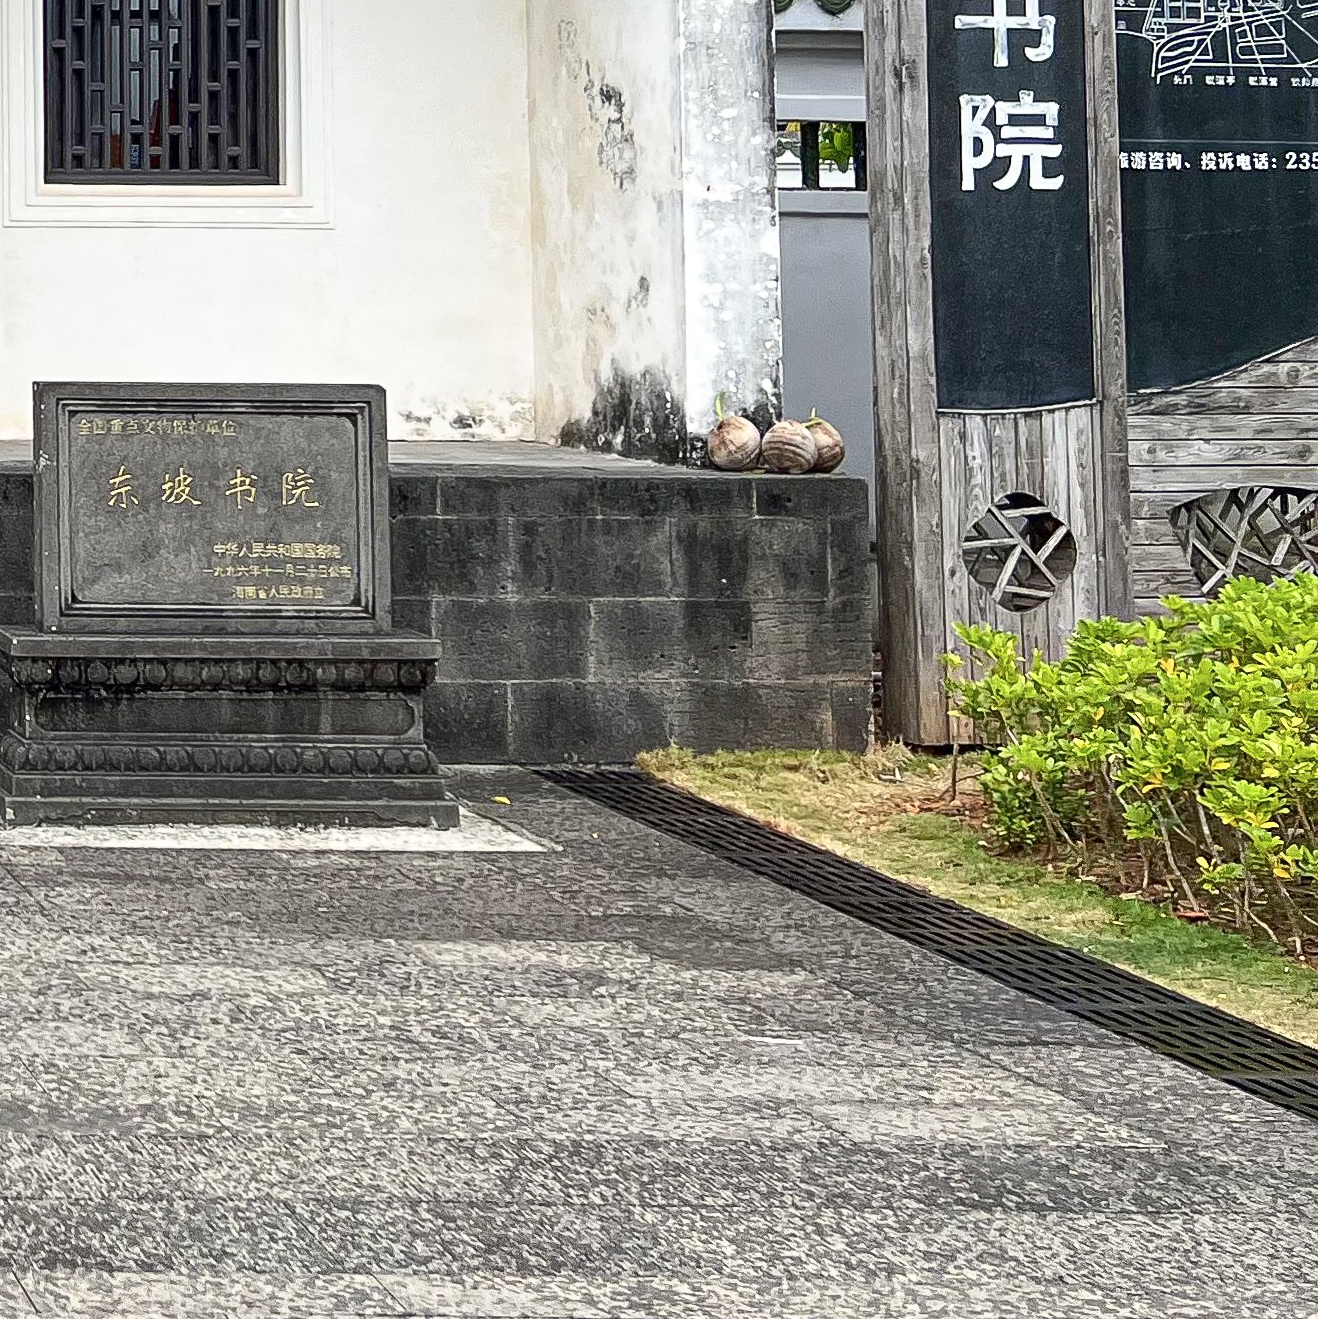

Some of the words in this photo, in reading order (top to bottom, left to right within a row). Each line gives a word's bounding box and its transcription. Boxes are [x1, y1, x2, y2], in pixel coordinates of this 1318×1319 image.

[77, 418, 237, 437] 全国重点文物保护单位
[107, 466, 324, 510] 东坡书院
[213, 542, 342, 559] 中华人民共和国国务院
